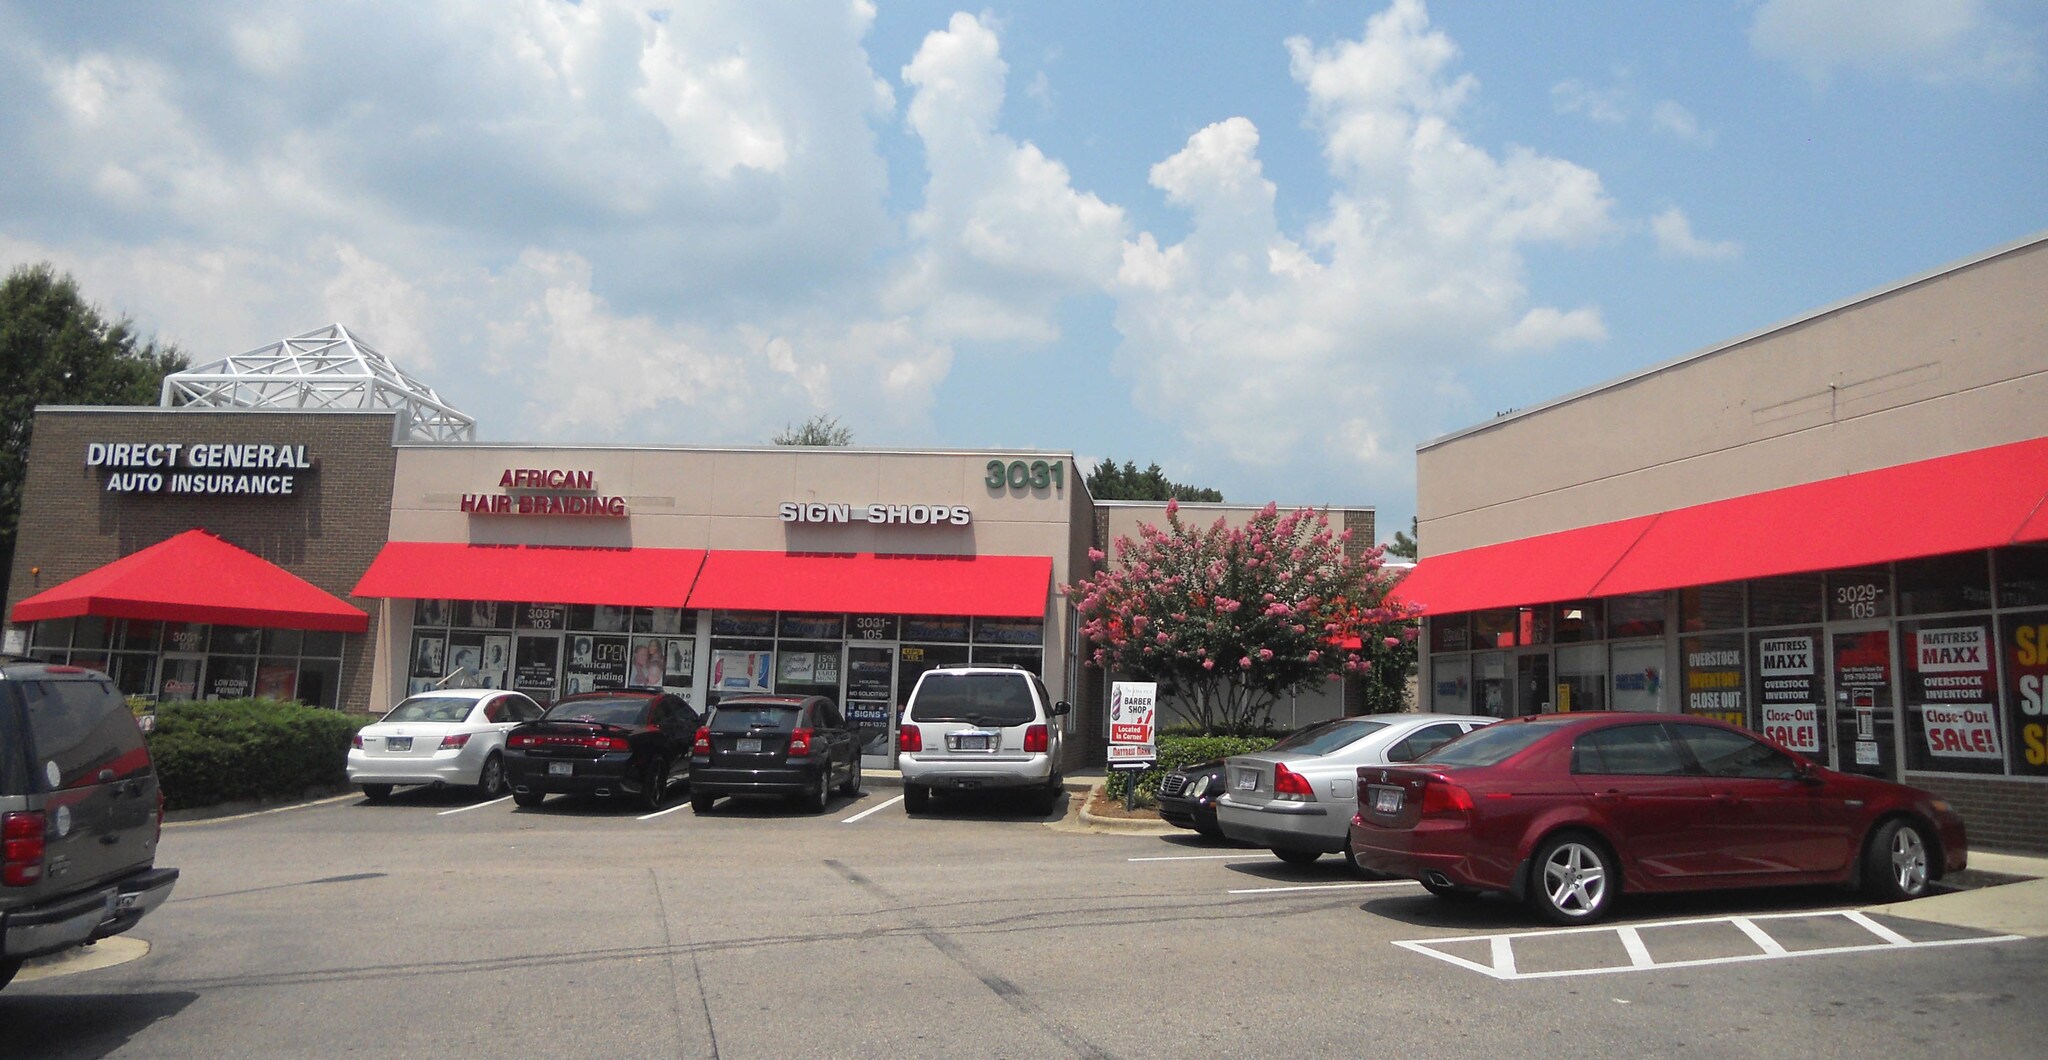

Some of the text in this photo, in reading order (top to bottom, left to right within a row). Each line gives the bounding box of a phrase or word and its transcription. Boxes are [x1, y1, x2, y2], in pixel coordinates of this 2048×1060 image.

[87, 443, 310, 468] DIRECT GENERAL
[498, 469, 594, 489] AFRICAN
[984, 460, 1064, 489] 3031
[107, 473, 293, 494] AUTO INSURANCE
[460, 494, 626, 516] HAIR BRAIDING
[778, 502, 971, 525] SIGN SHOPS
[1837, 584, 1884, 603] 3029-
[1849, 601, 1875, 619] 105
[532, 620, 551, 630] 103
[857, 618, 891, 628] 3031-
[862, 630, 882, 640] 105
[1923, 631, 1979, 644] MATTRESS
[597, 643, 628, 660] OPEN
[1763, 641, 1807, 651] MATTRESS
[818, 654, 837, 662] 15%
[1689, 651, 1740, 667] OVERSTOCK
[1763, 654, 1808, 669] MAXX
[1922, 647, 1980, 664] MAXX
[1764, 679, 1809, 689] OVERSTOCK
[1924, 676, 1982, 687] OVERSTOCK
[215, 687, 244, 695] PAYMENT
[1765, 691, 1809, 700] INVENTORY
[1926, 689, 1982, 699] INVENTORY
[1124, 697, 1152, 705] BARBER
[1690, 691, 1741, 709] CLOSE OUT
[854, 710, 881, 718] SIGNS
[1128, 706, 1147, 714] SHOP
[1766, 709, 1814, 721] Close-Out
[1926, 709, 1988, 723] Close-Out
[1765, 726, 1814, 747] SALE!
[1929, 728, 1995, 752] SALE!
